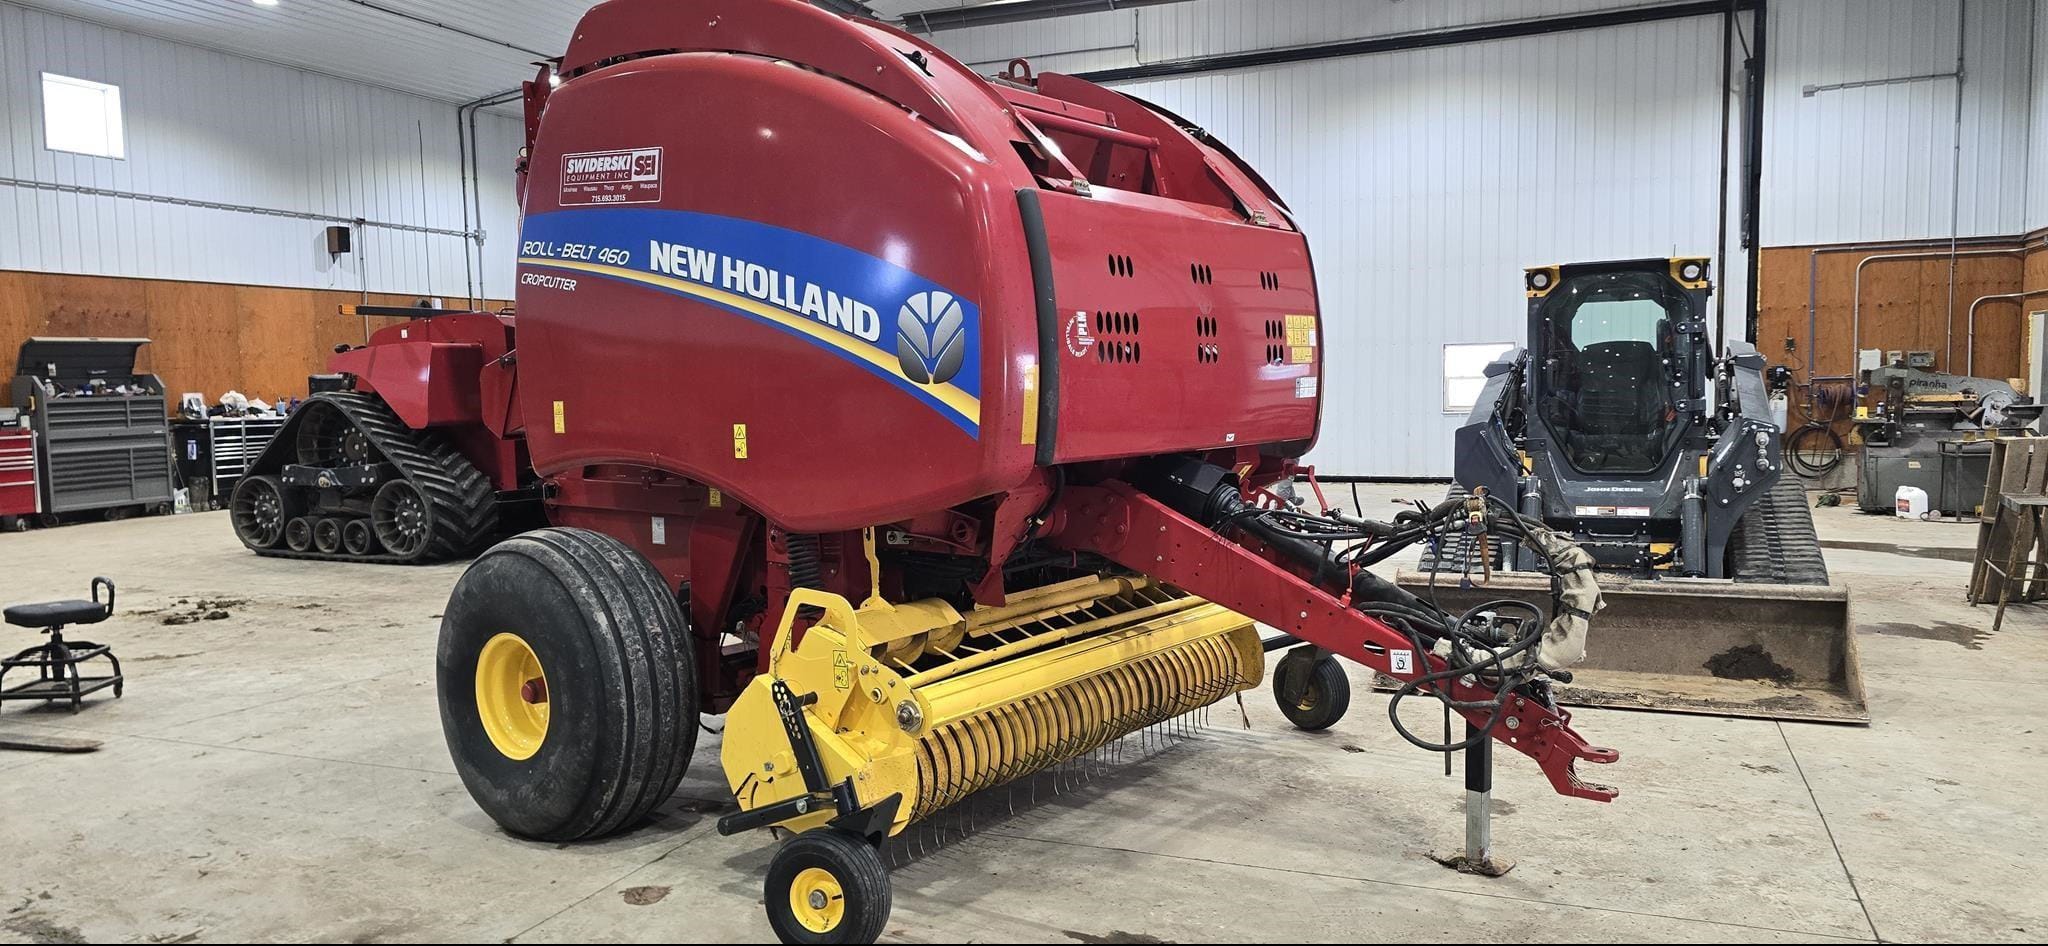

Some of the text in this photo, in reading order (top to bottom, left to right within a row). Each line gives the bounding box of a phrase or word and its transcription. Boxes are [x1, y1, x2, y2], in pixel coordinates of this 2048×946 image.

[566, 155, 631, 174] SWIDERSKI
[633, 154, 656, 176] SEI
[566, 171, 629, 182] EQUIPMENT INC
[522, 241, 630, 265] ROLL-BELT 460
[521, 273, 577, 291] CROPCUTTER
[650, 239, 881, 342] NEW HOLLAND
[1908, 377, 1948, 389] piranha
